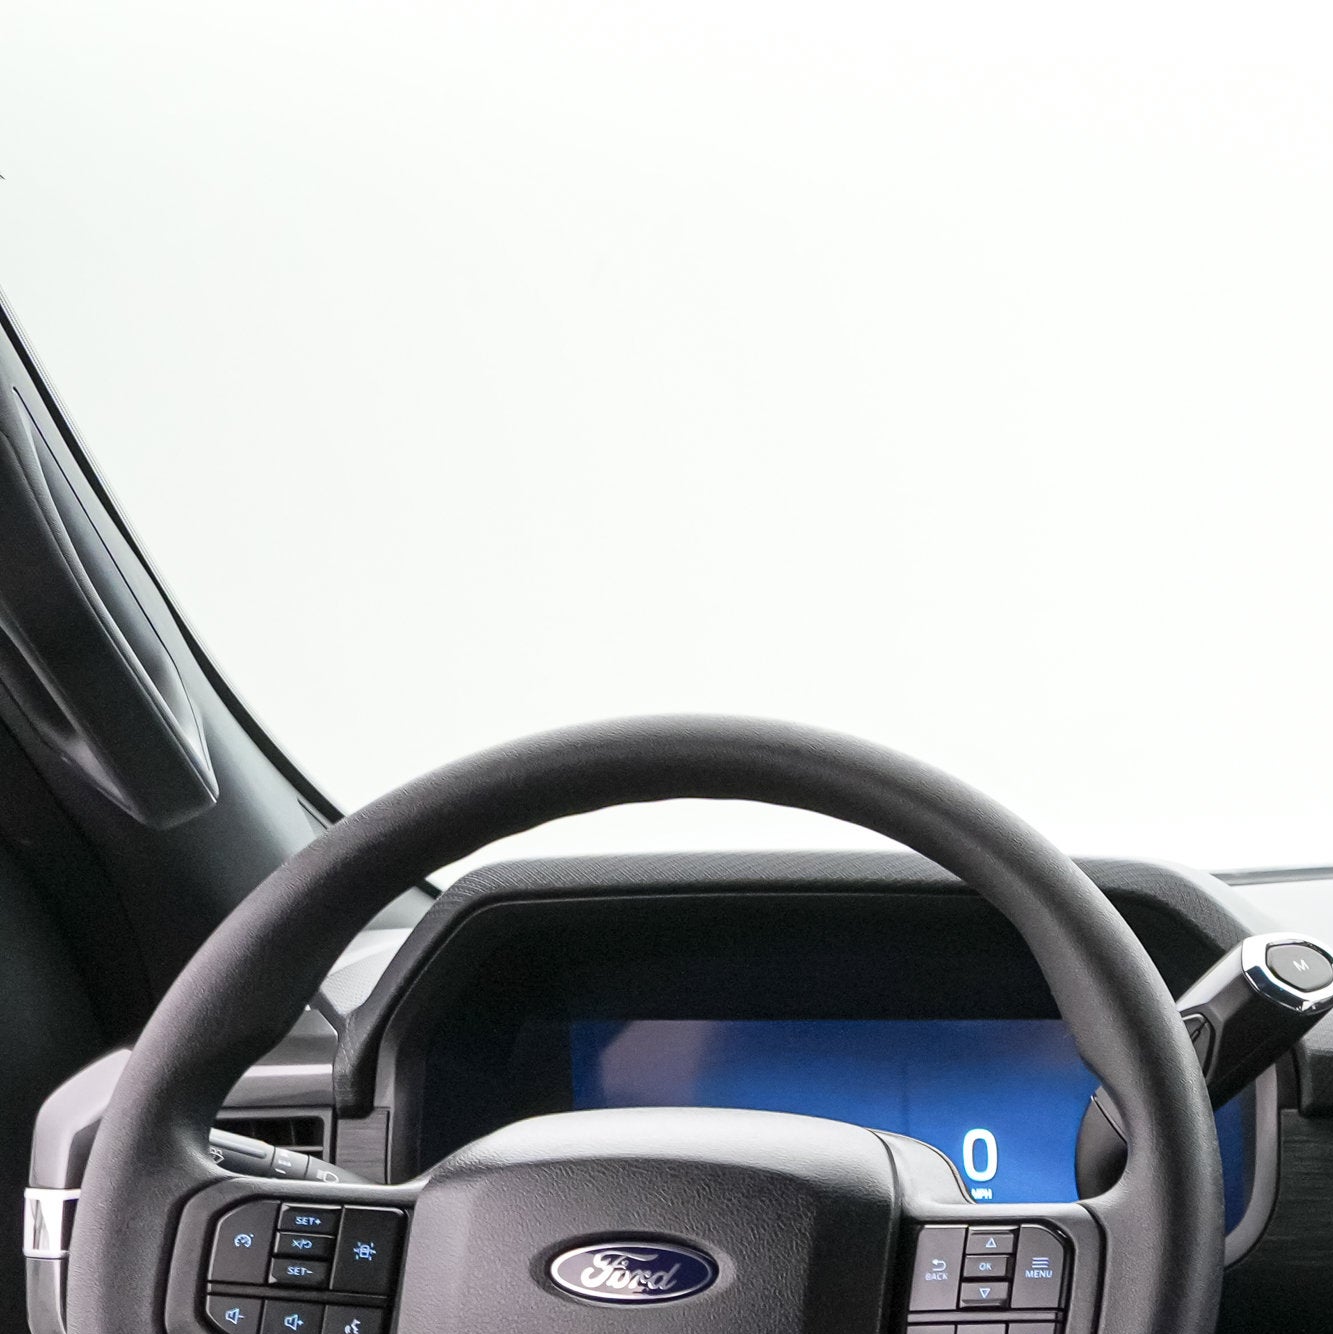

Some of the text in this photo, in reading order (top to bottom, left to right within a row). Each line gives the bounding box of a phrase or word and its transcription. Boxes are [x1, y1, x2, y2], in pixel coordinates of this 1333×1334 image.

[1293, 959, 1310, 972] M
[962, 1129, 998, 1182] 0
[296, 1215, 322, 1226] SET+
[287, 1267, 314, 1276] SET-
[979, 1262, 993, 1271] OK
[580, 1252, 678, 1294] Ford
[925, 1271, 949, 1282] BACK
[1025, 1269, 1053, 1279] MENU
